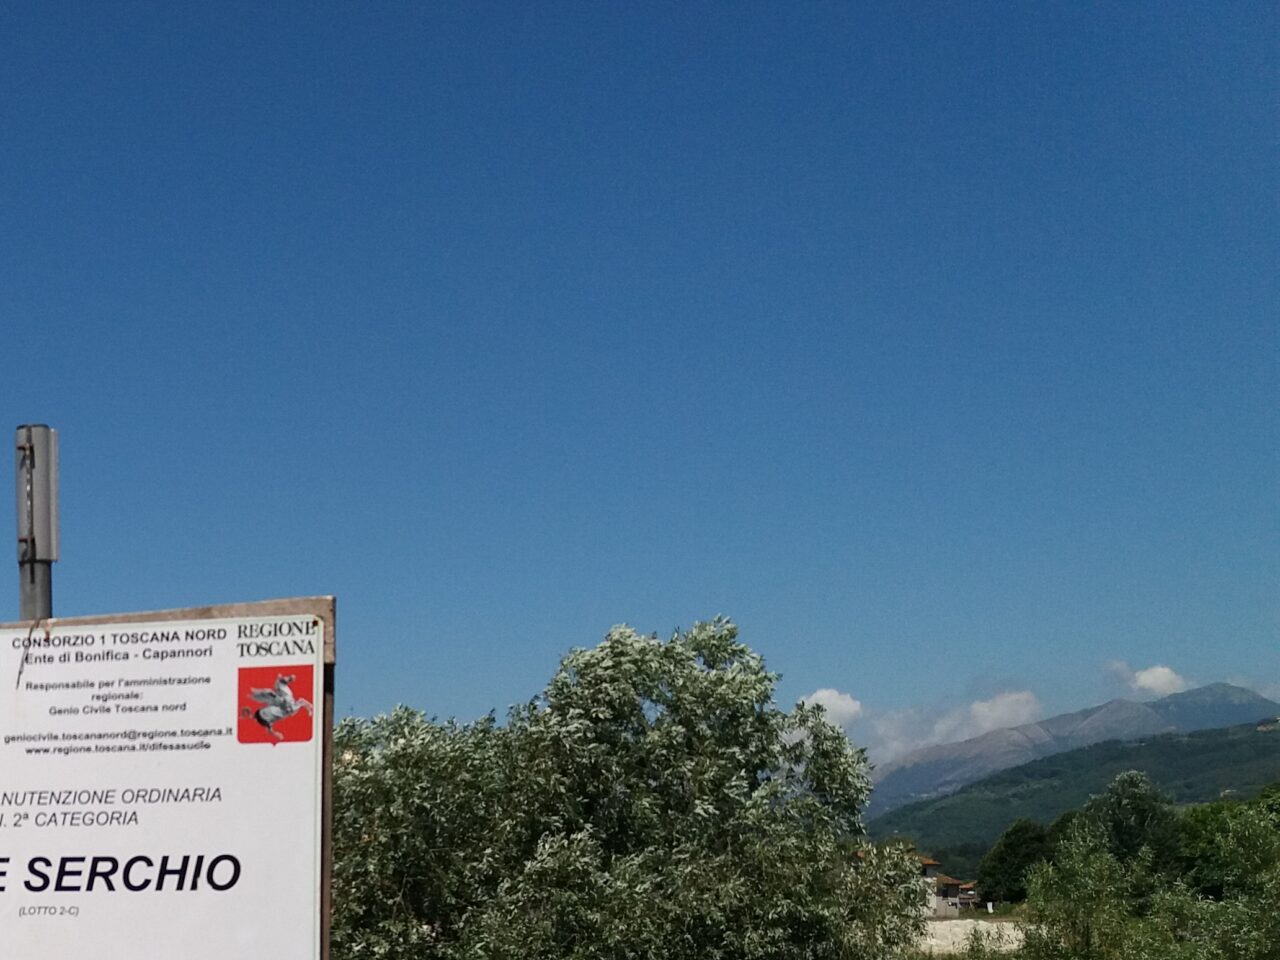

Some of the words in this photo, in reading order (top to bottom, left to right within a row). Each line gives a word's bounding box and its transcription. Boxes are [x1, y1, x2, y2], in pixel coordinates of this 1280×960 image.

[237, 621, 316, 639] REGIONE
[12, 635, 95, 649] CONSORZIO
[100, 635, 106, 646] 1
[111, 631, 180, 645] TOSCANA
[185, 629, 227, 641] NORD
[25, 653, 54, 664] Ente
[59, 652, 71, 663] di
[75, 650, 129, 663] Bonifica
[143, 646, 213, 661] Capannori
[237, 640, 315, 658] TOSCANA
[25, 680, 95, 691] Responsabile
[98, 680, 115, 690] per
[49, 706, 79, 715] Genio
[82, 704, 111, 715] Civile
[115, 703, 158, 713] Toscana
[162, 702, 187, 711] nord
[121, 787, 223, 804] ORDINARIA
[34, 811, 139, 827] CATEGORIA
[24, 854, 241, 893] SERCHIO
[19, 905, 57, 917] (LOTTO
[59, 906, 79, 917] 2-C)
